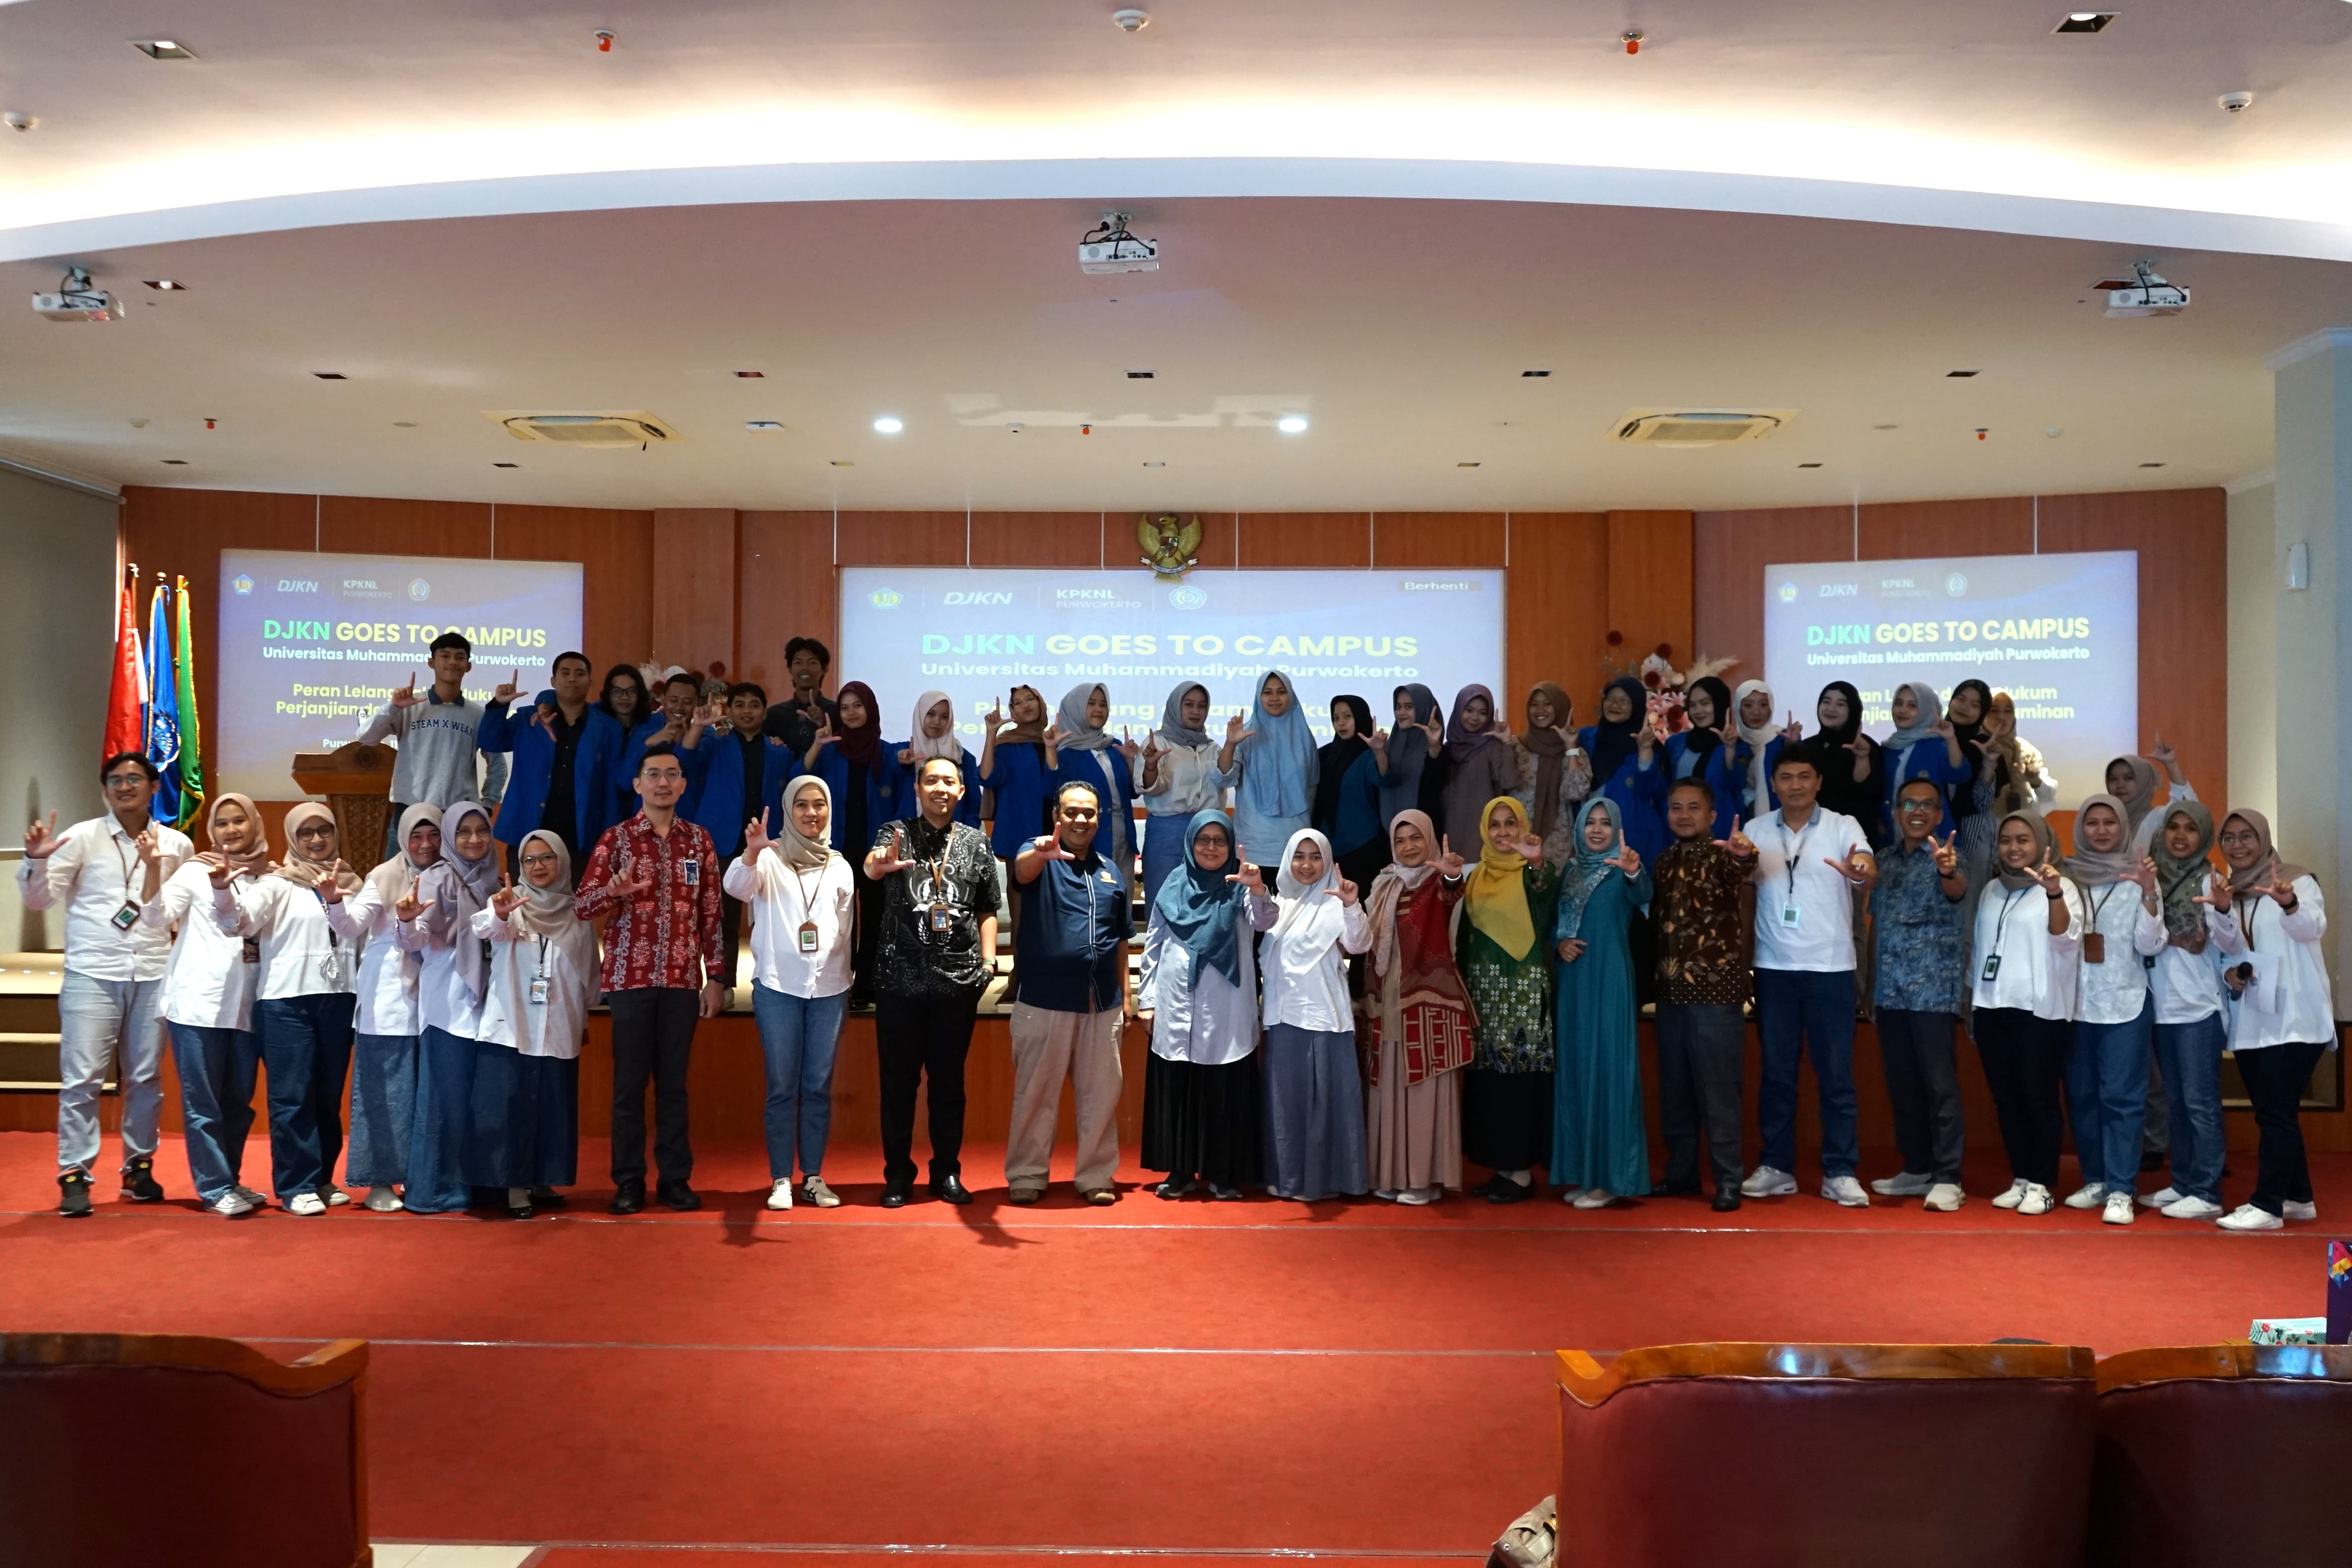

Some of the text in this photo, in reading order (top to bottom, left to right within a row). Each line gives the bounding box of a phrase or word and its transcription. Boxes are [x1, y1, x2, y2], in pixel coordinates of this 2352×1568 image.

[277, 580, 318, 592] DJKN
[343, 580, 378, 589] KPKNL
[1405, 581, 1469, 591] Berhenti
[1882, 579, 1915, 589] KPKNL
[1057, 589, 1115, 599] KPKNL
[1819, 584, 1858, 597] DJKN
[943, 592, 1013, 605] DJKN
[1057, 601, 1141, 609] PURWOKERTO
[264, 620, 330, 640] DJKN
[336, 622, 400, 642] GOES
[406, 624, 438, 644] TO
[1808, 617, 2089, 646] DJKN GOES TO CAMPUS
[922, 634, 1418, 657] DJKN GOES TO CAMPUS
[263, 646, 343, 661] Universitas
[1808, 646, 2090, 665] Universitas Muhammadiyah Purwokerto
[921, 663, 1058, 675] Universitas
[293, 683, 340, 697] Peran
[411, 719, 439, 730] STEAM
[442, 720, 448, 728] X
